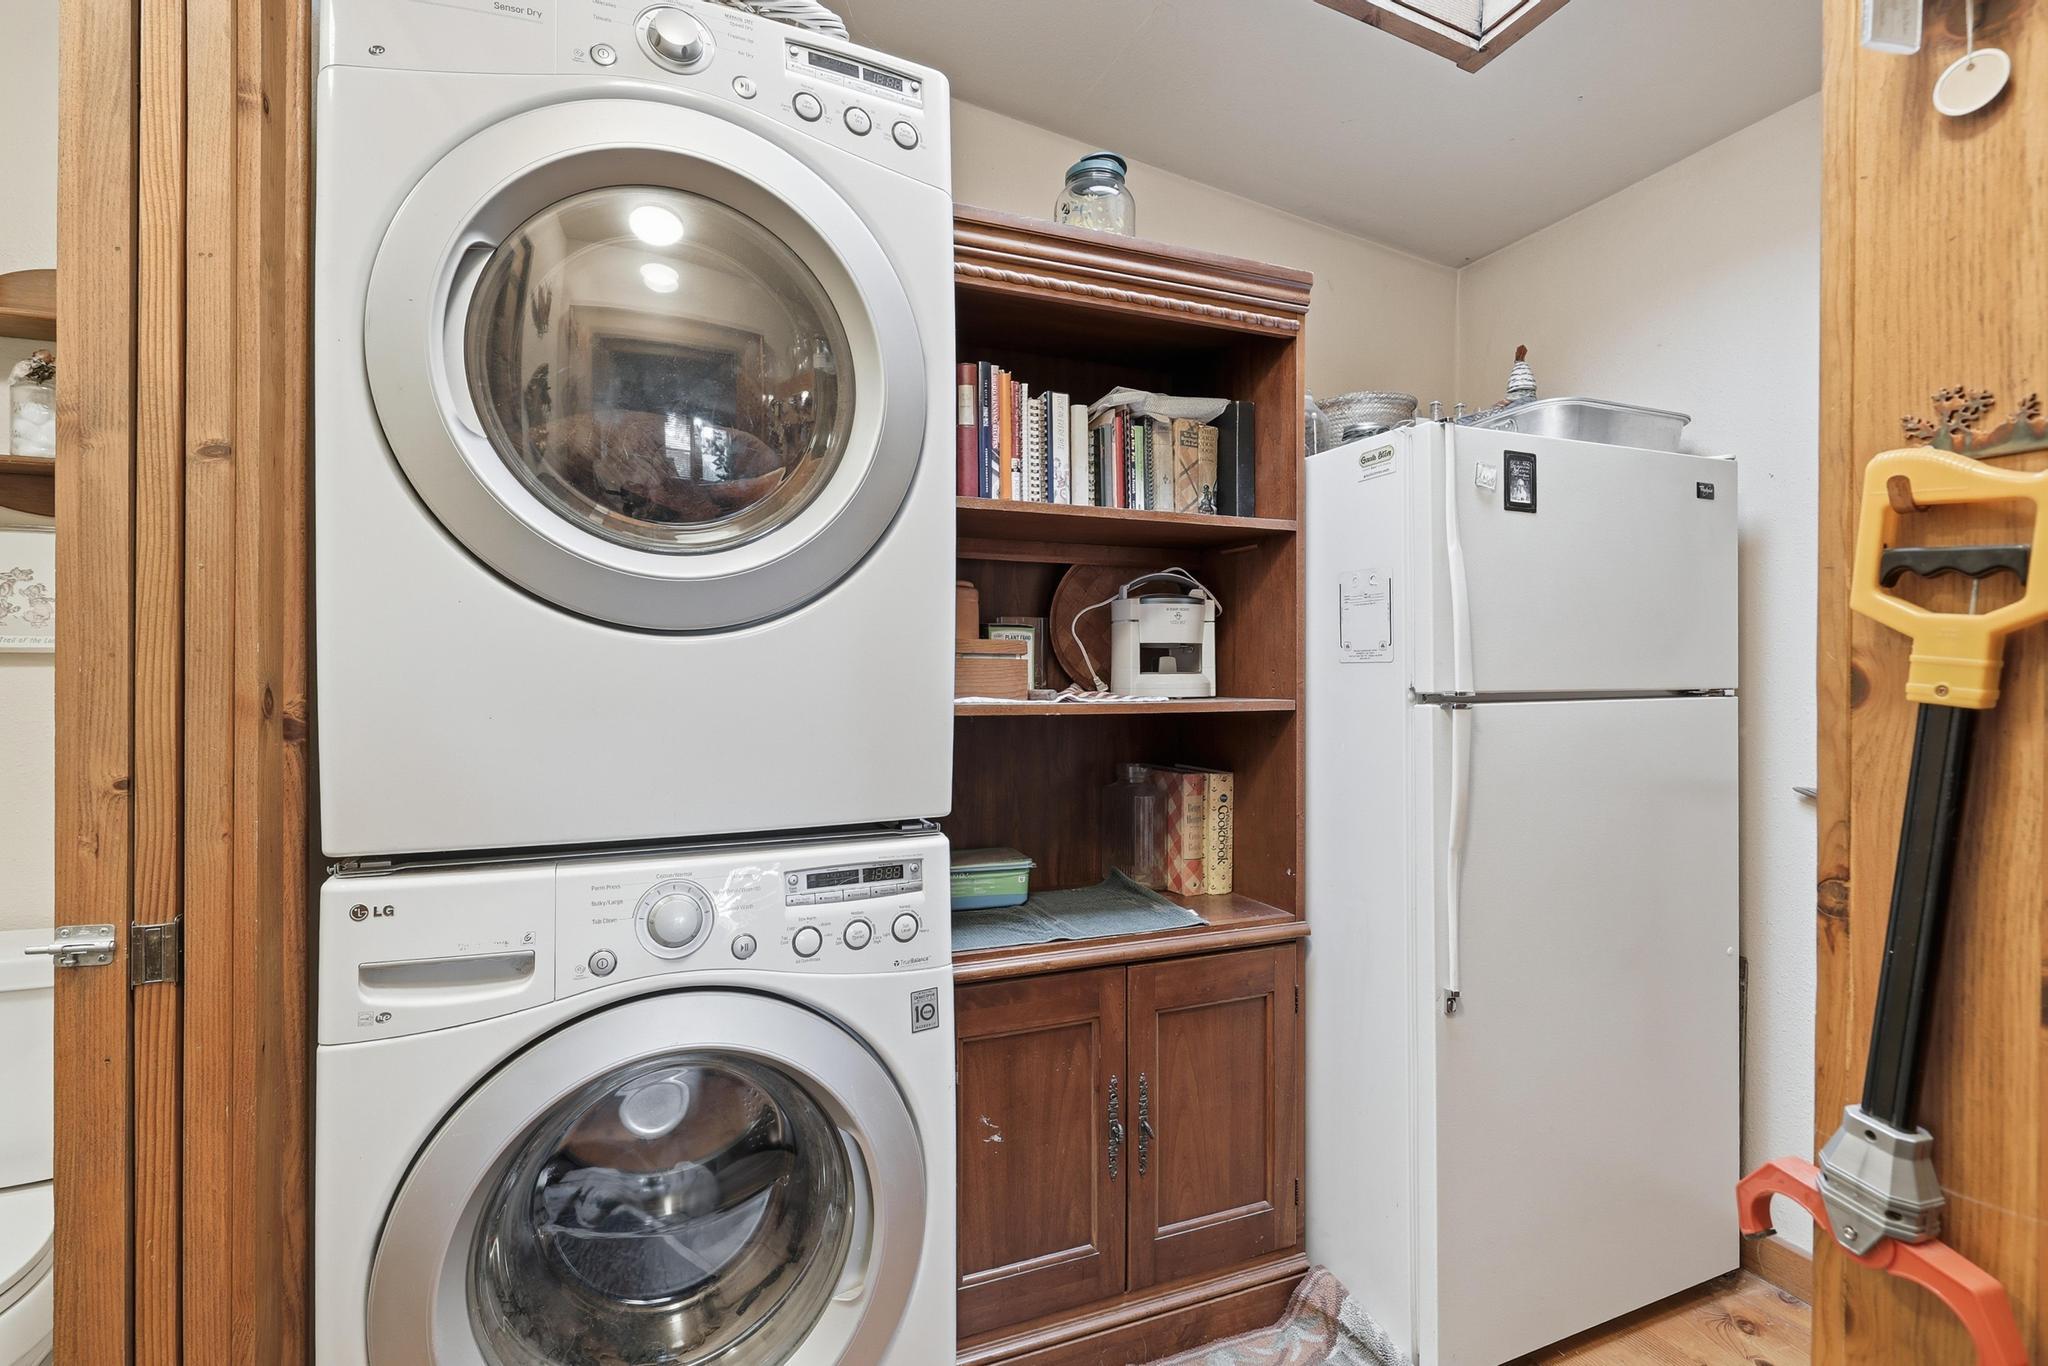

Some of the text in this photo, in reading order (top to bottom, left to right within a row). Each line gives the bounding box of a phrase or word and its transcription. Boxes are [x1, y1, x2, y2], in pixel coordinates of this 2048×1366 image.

[493, 1, 542, 18] Sensor Dry
[1217, 805, 1229, 865] Cookbook
[373, 904, 395, 918] LG
[914, 1003, 936, 1023] 10
